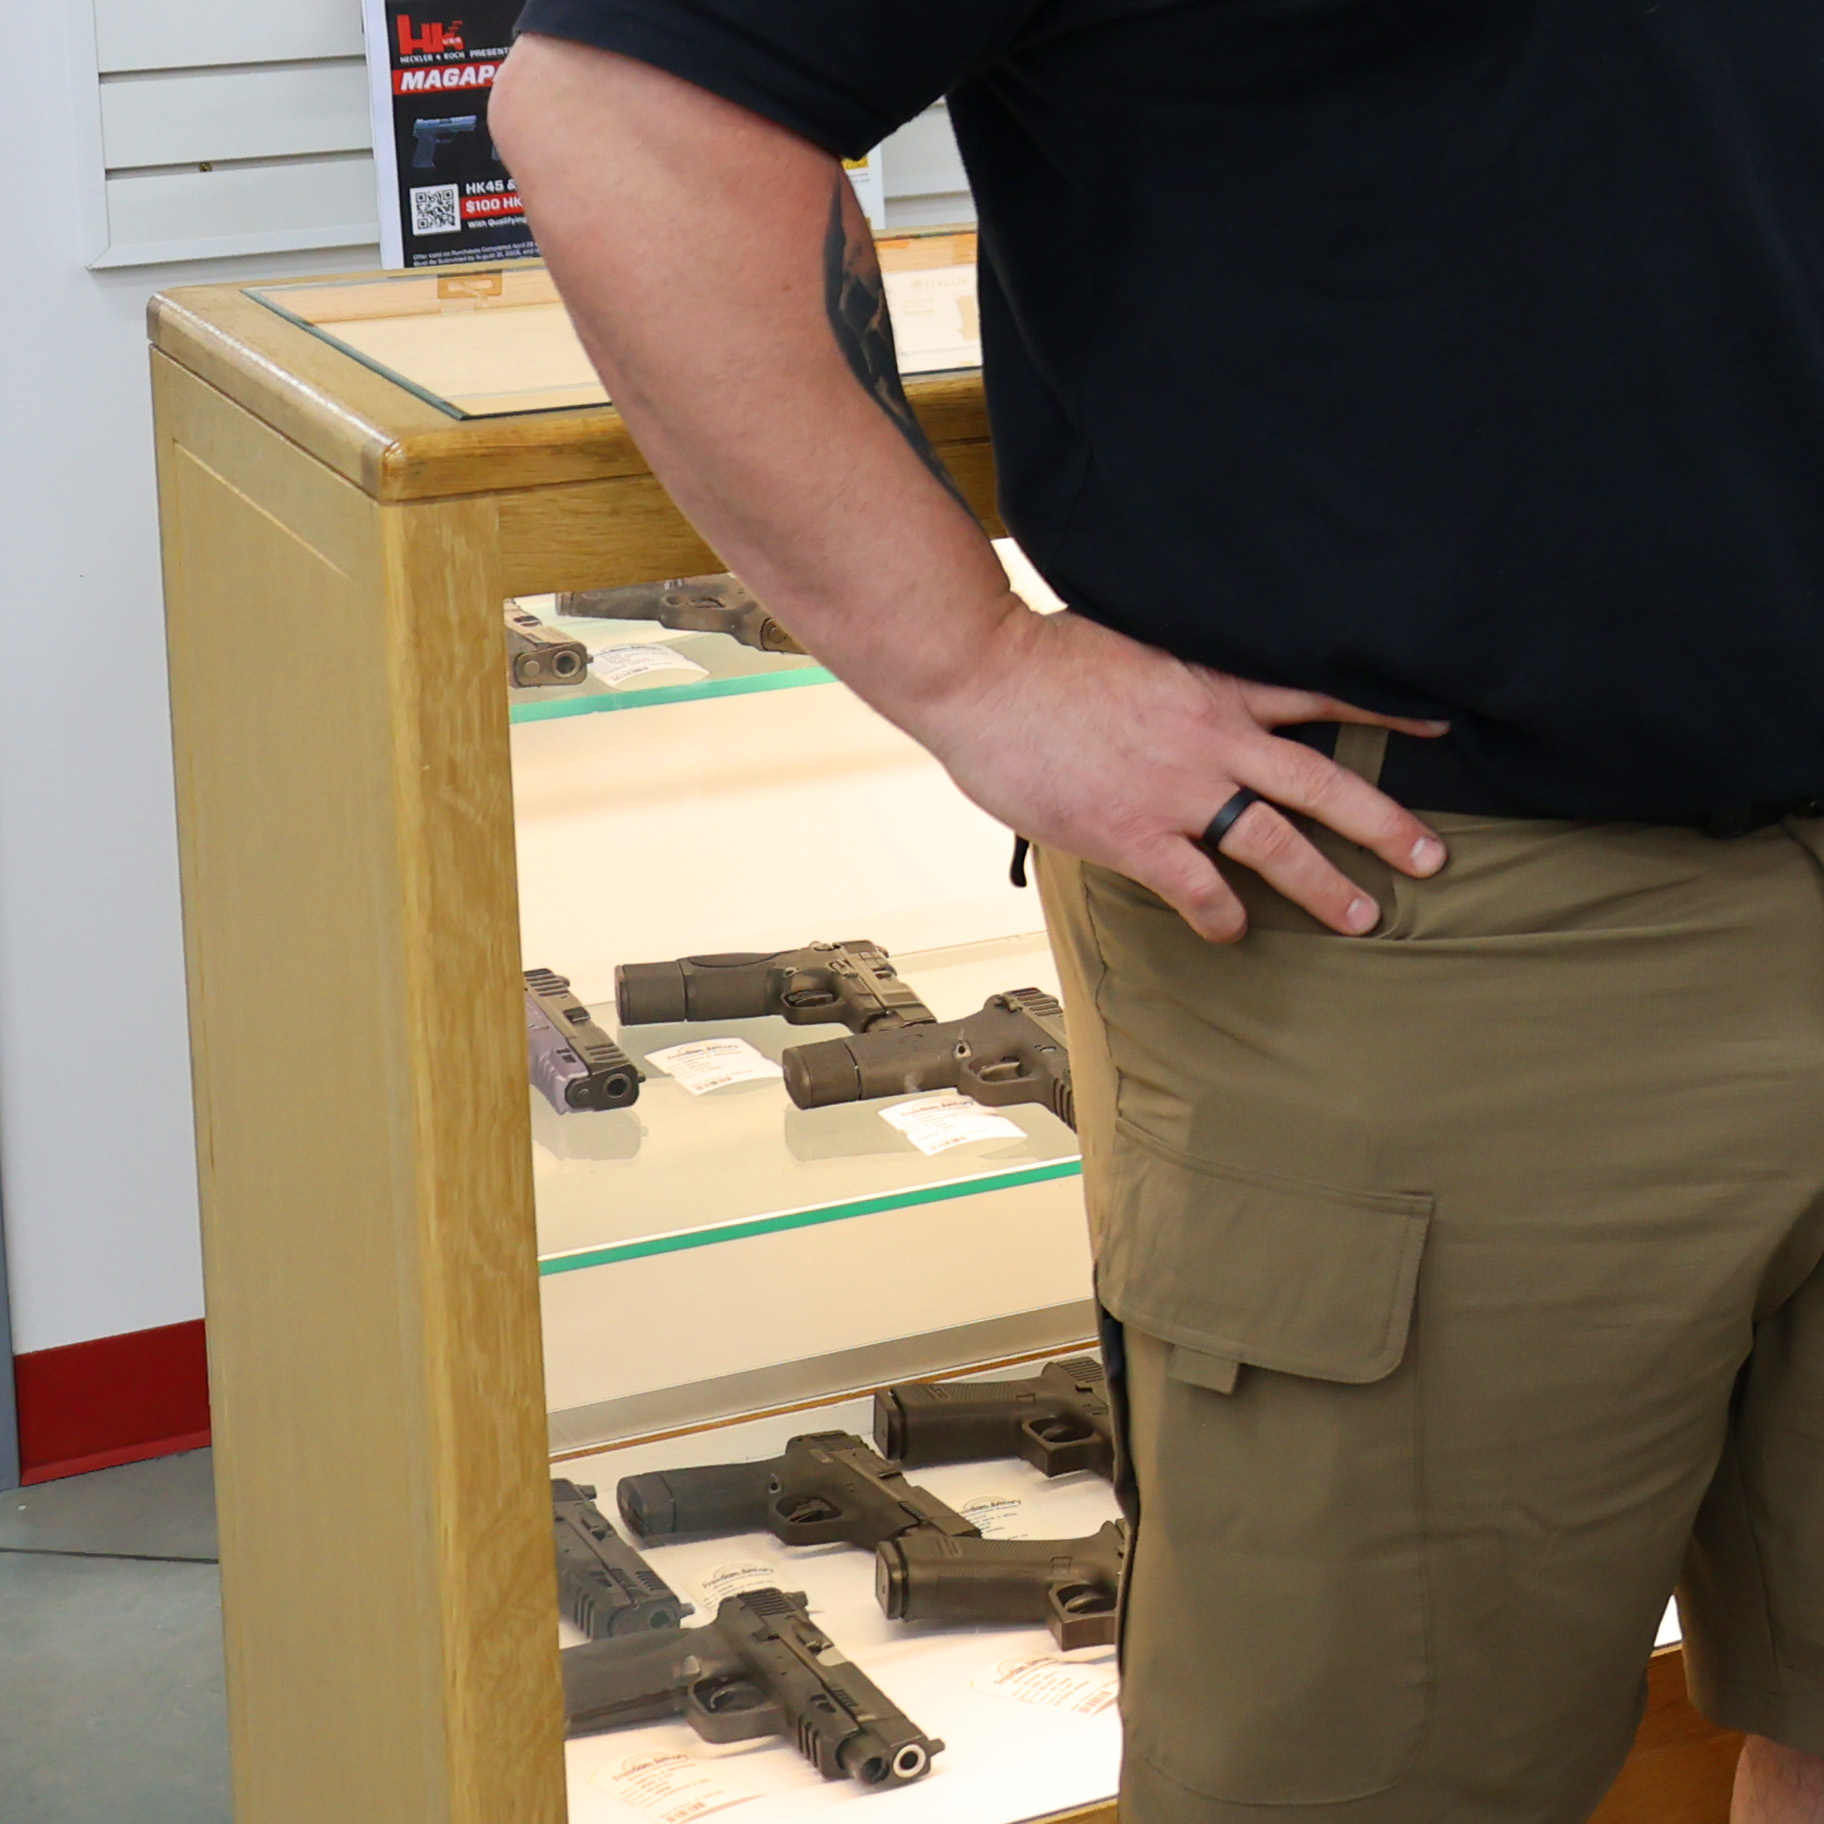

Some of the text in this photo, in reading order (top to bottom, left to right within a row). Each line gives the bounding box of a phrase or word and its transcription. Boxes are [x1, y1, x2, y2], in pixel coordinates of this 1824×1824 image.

[443, 51, 465, 61] KOCH
[469, 46, 510, 58] PRESENT
[401, 64, 497, 91] MAGAP
[466, 179, 504, 195] HK45
[466, 196, 523, 213] $100 HK
[468, 216, 528, 228] With Qualifying
